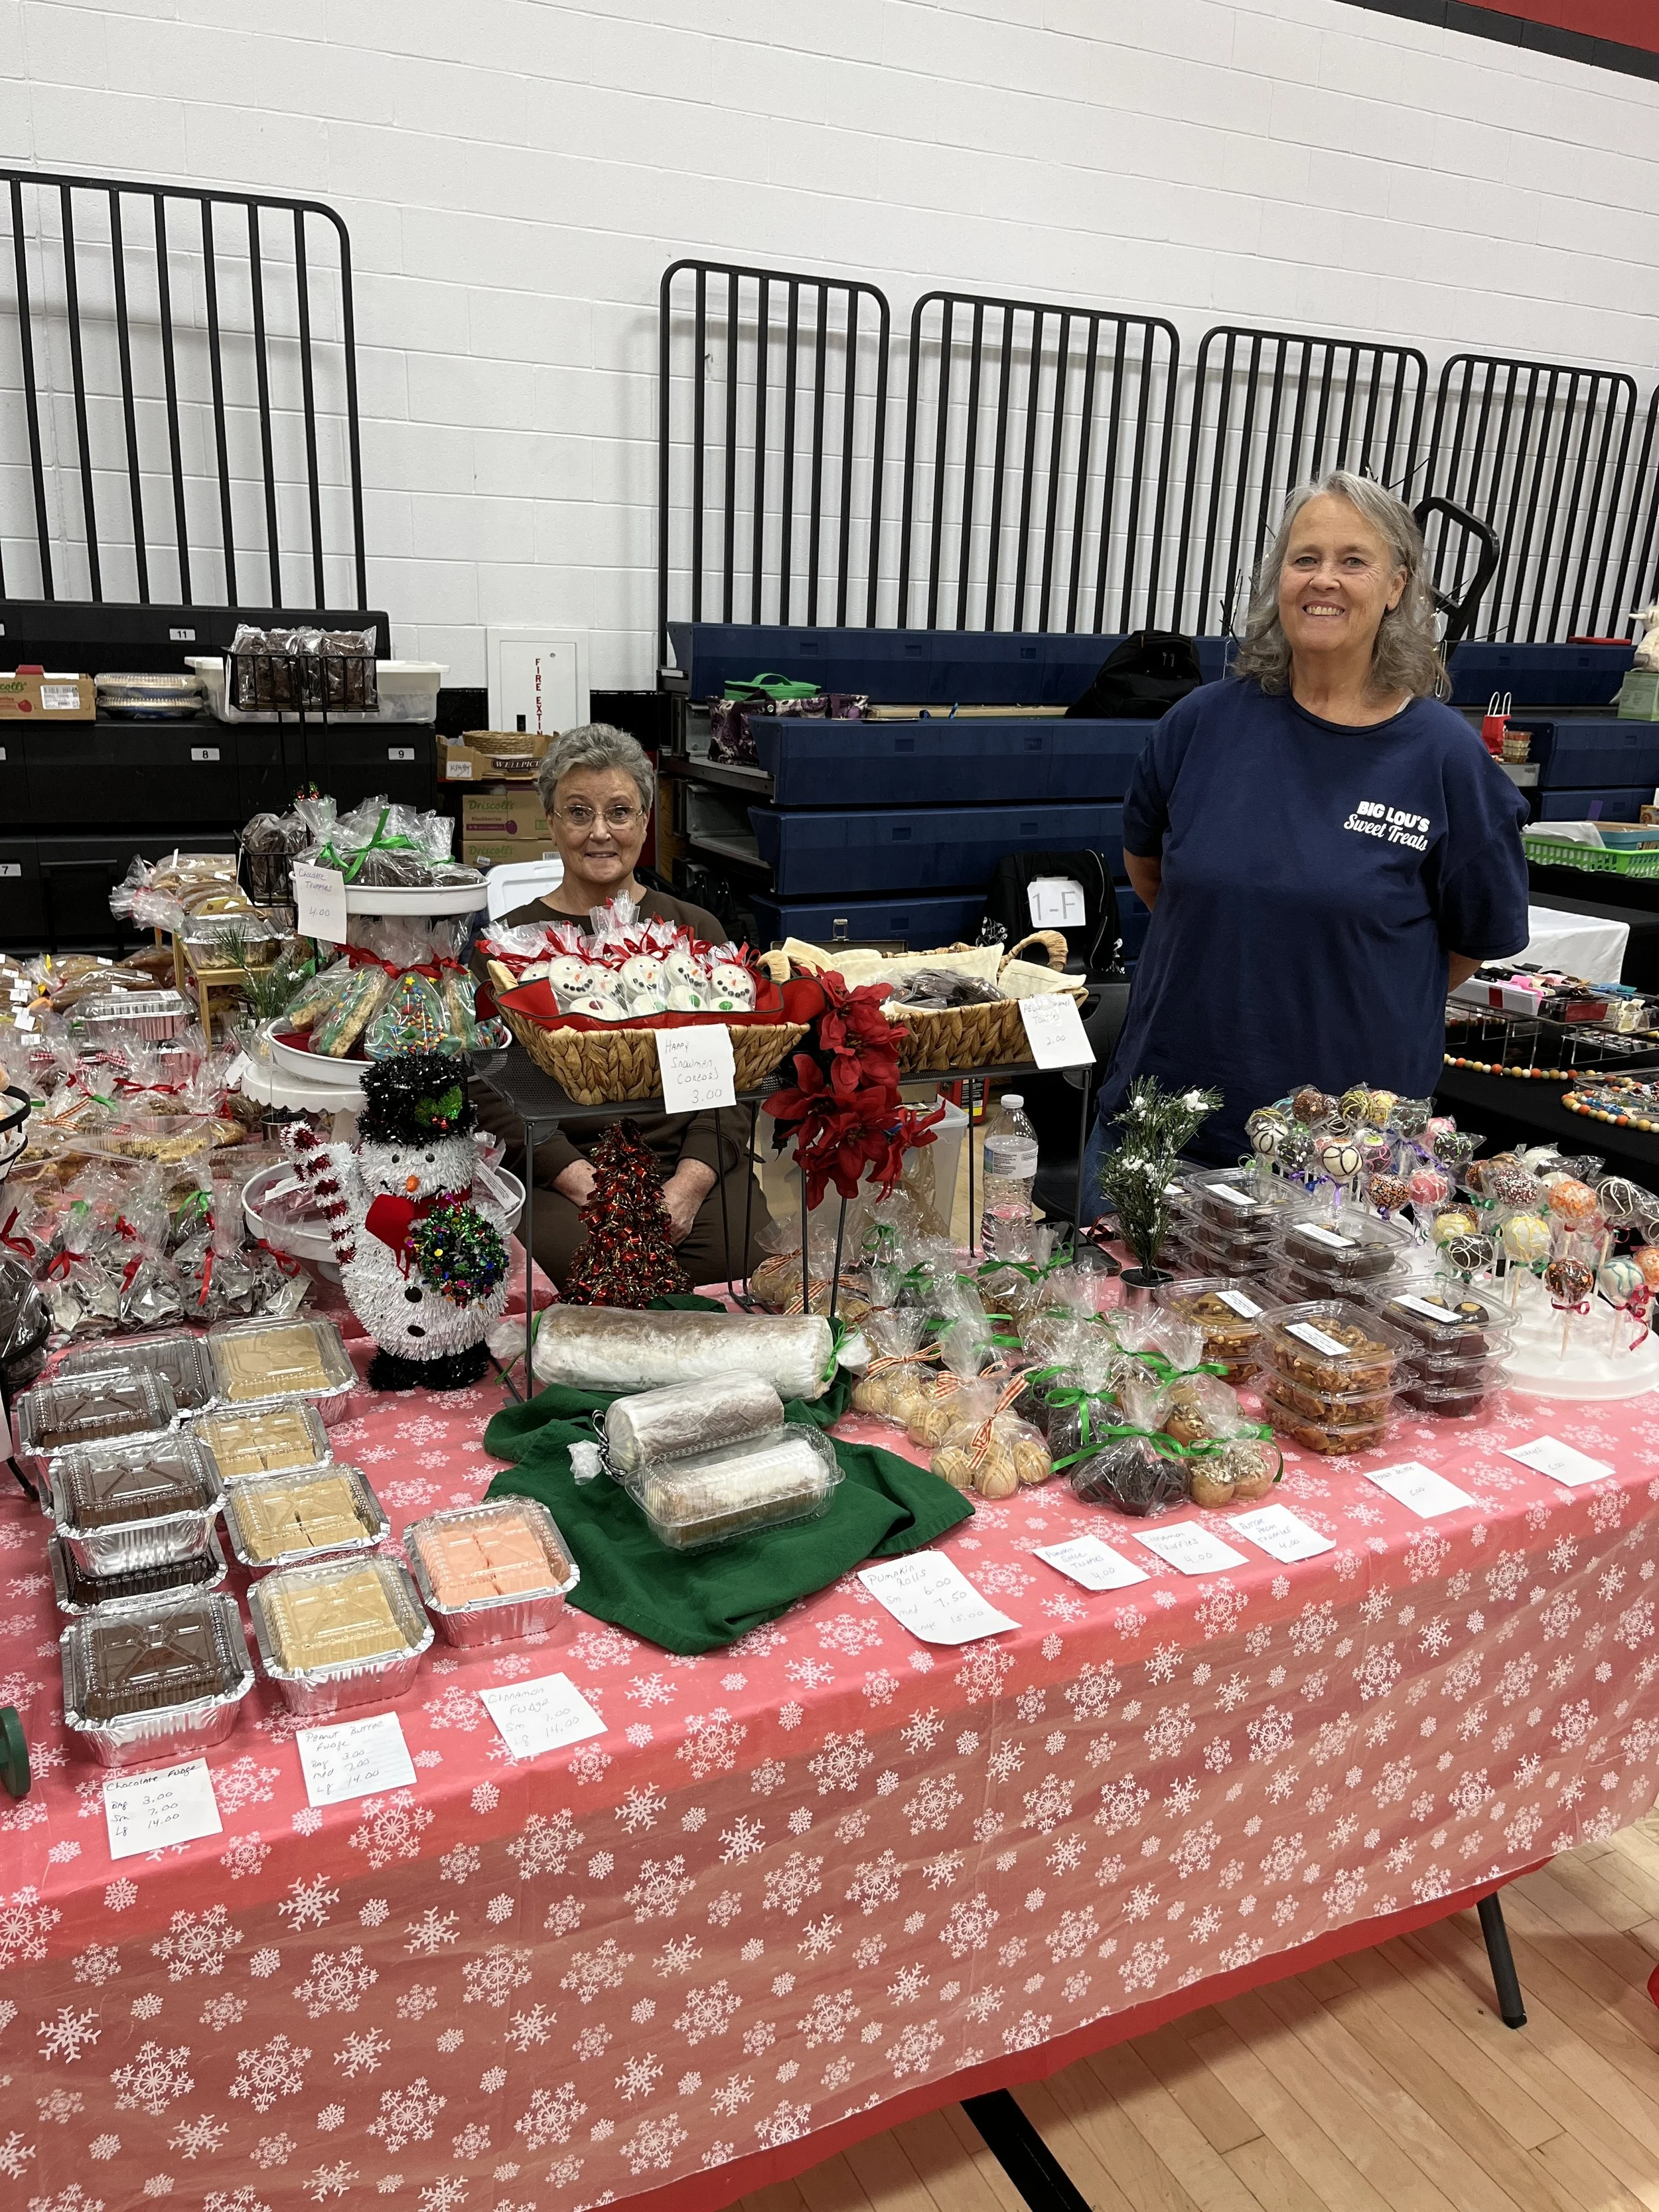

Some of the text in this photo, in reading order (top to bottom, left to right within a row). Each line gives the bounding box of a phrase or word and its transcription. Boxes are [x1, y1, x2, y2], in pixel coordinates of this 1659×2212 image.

[202, 750, 208, 759] 8
[398, 750, 404, 759] 9
[469, 800, 516, 810] Driscoll's
[1356, 800, 1430, 832] BIG LOU'S
[1343, 814, 1429, 851] Sweet Treats
[2, 865, 9, 874] 7
[309, 906, 330, 917] 4.00
[1033, 891, 1075, 921] 1-F
[1046, 1035, 1066, 1046] 2.00
[692, 1089, 722, 1103] 3.00
[1278, 1538, 1300, 1549] 4.00
[1183, 1552, 1213, 1564] 4.00
[1091, 1567, 1115, 1580] 4.00
[924, 1578, 952, 1595] 6.00
[934, 1591, 967, 1609] 7.50
[950, 1610, 984, 1623] 15.00
[541, 1708, 571, 1722] 7.00
[545, 1716, 579, 1737] 14.00
[342, 1749, 365, 1760] 3.00
[344, 1758, 370, 1772] 7.00
[348, 1769, 379, 1787] 14.00
[143, 1791, 173, 1805] 3.00
[147, 1803, 179, 1816] 7.00
[148, 1813, 179, 1829] 14.00
